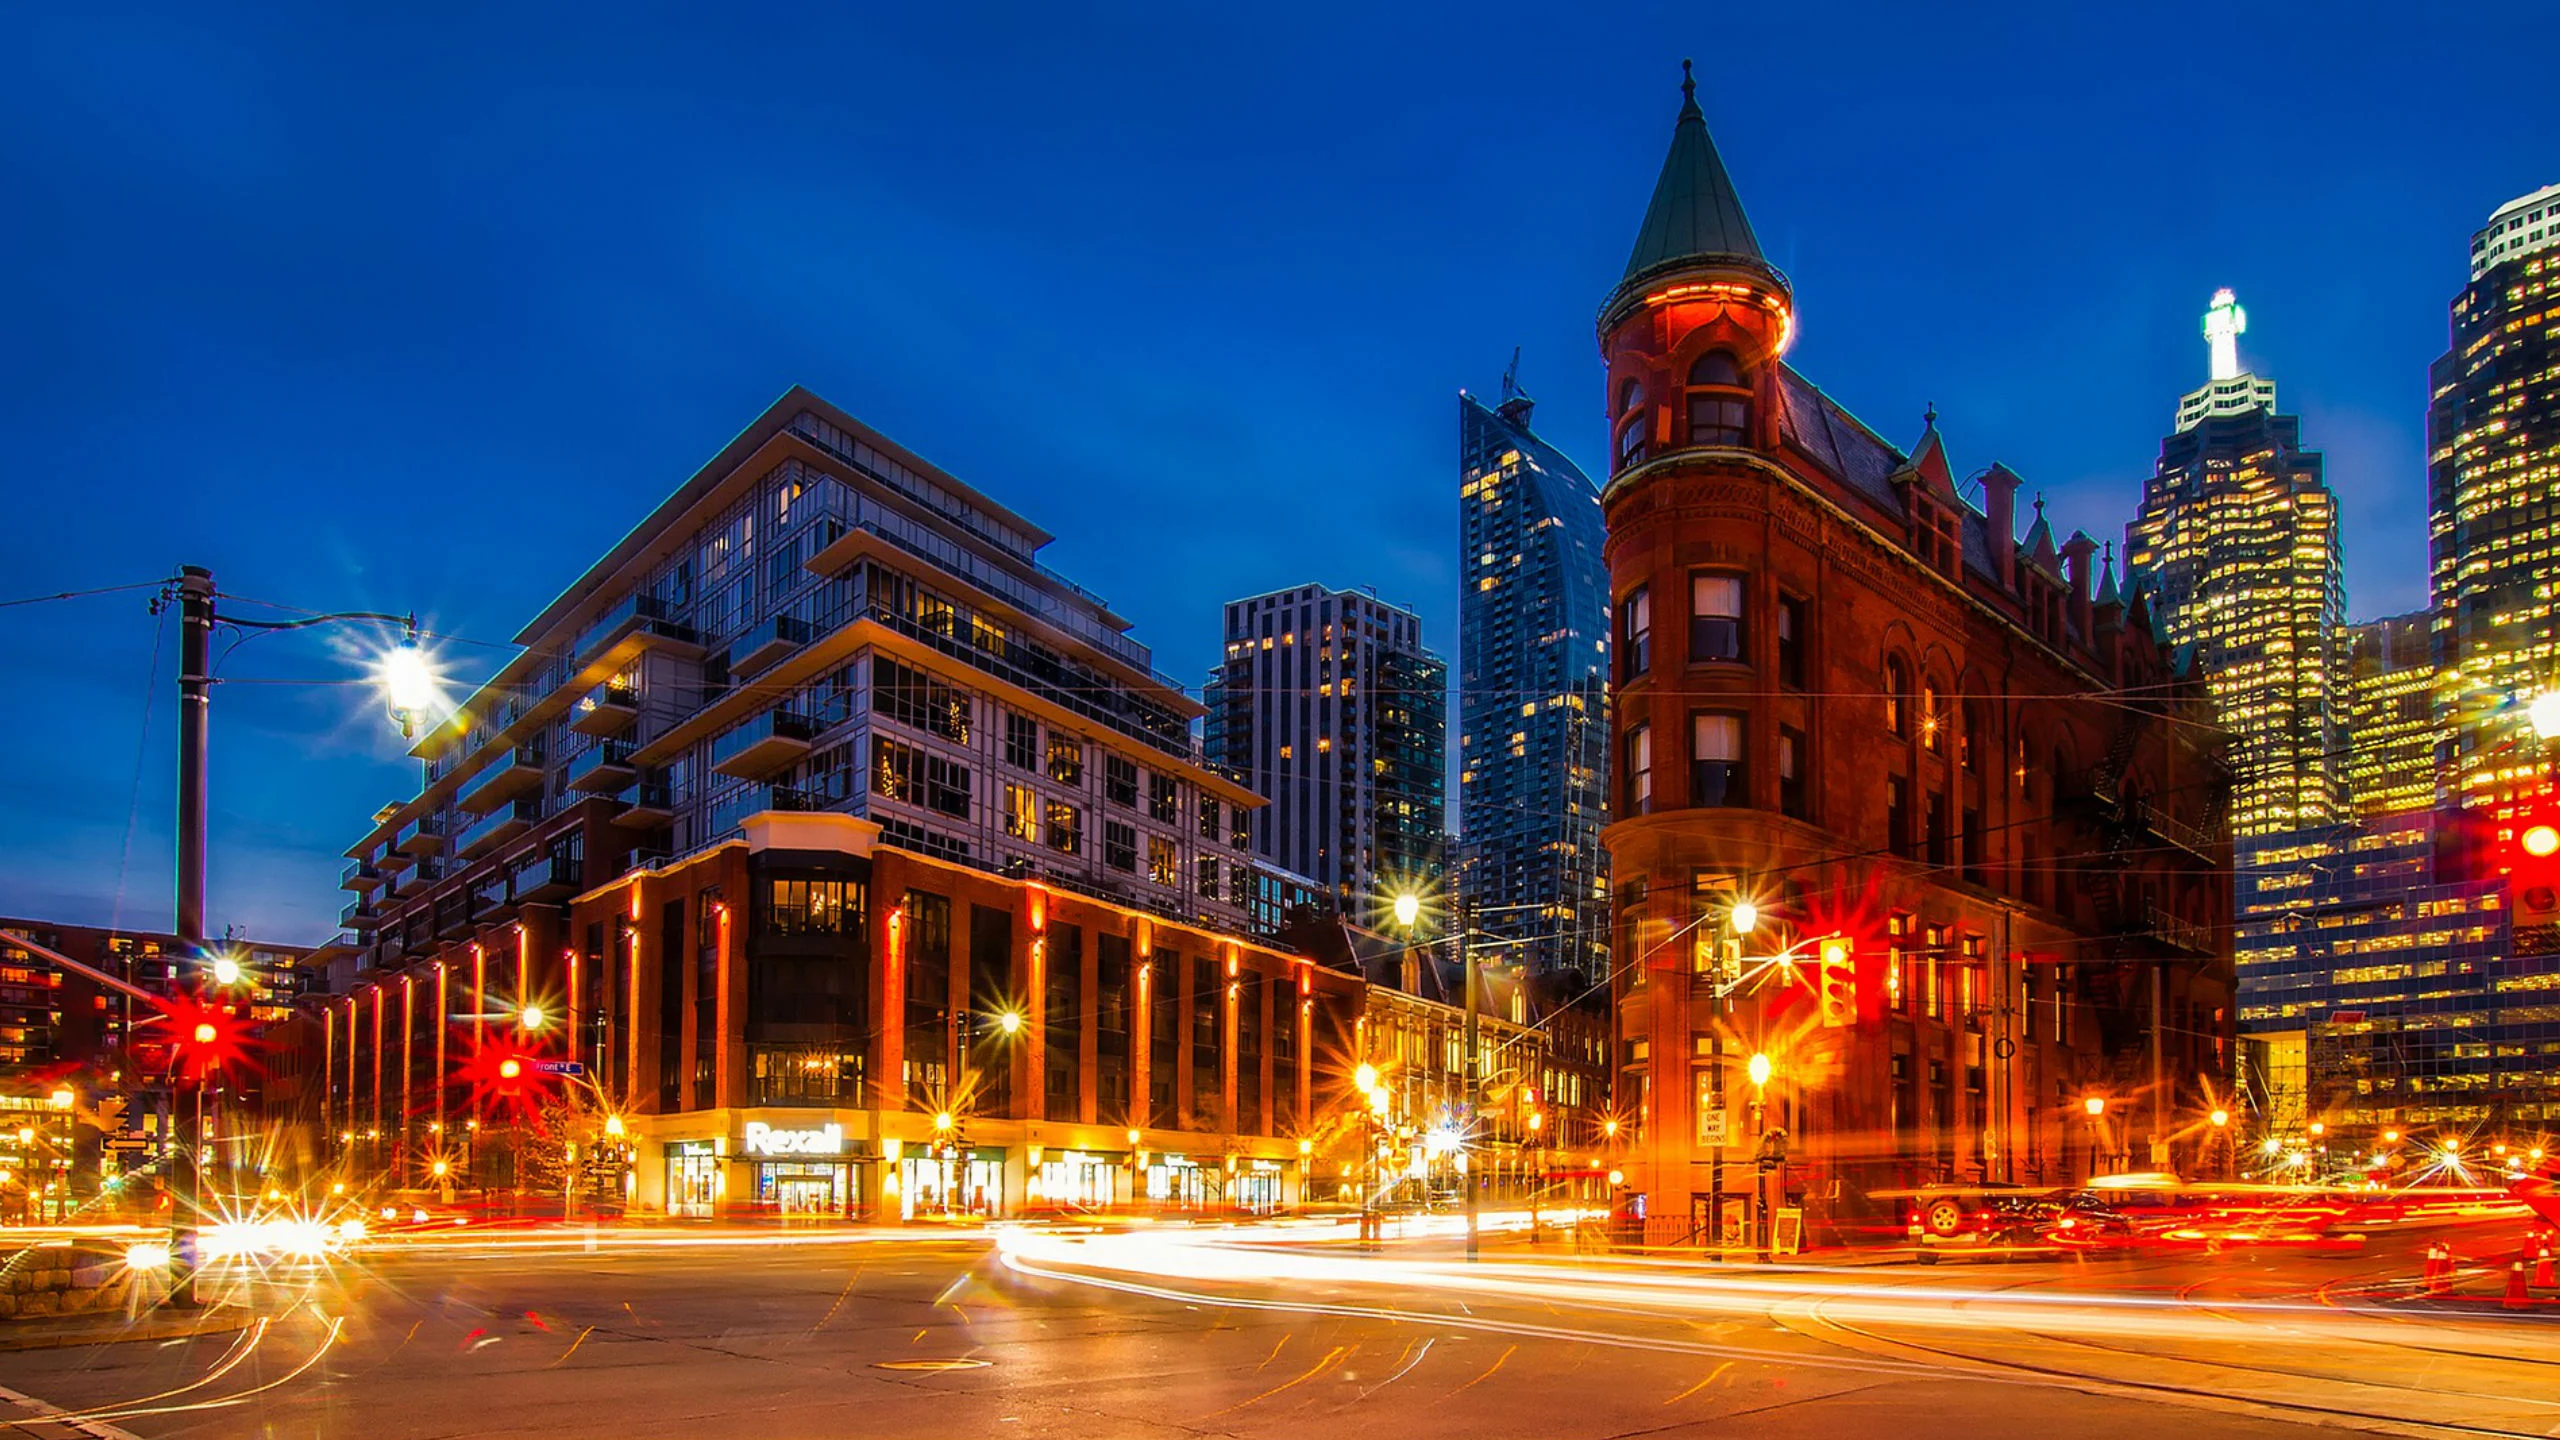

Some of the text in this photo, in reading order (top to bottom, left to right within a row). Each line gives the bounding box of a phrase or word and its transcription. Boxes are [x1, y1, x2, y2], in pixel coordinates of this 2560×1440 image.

[1706, 1113, 1720, 1122] ONE
[1707, 1124, 1720, 1132] WAY
[745, 1121, 842, 1156] Rexall
